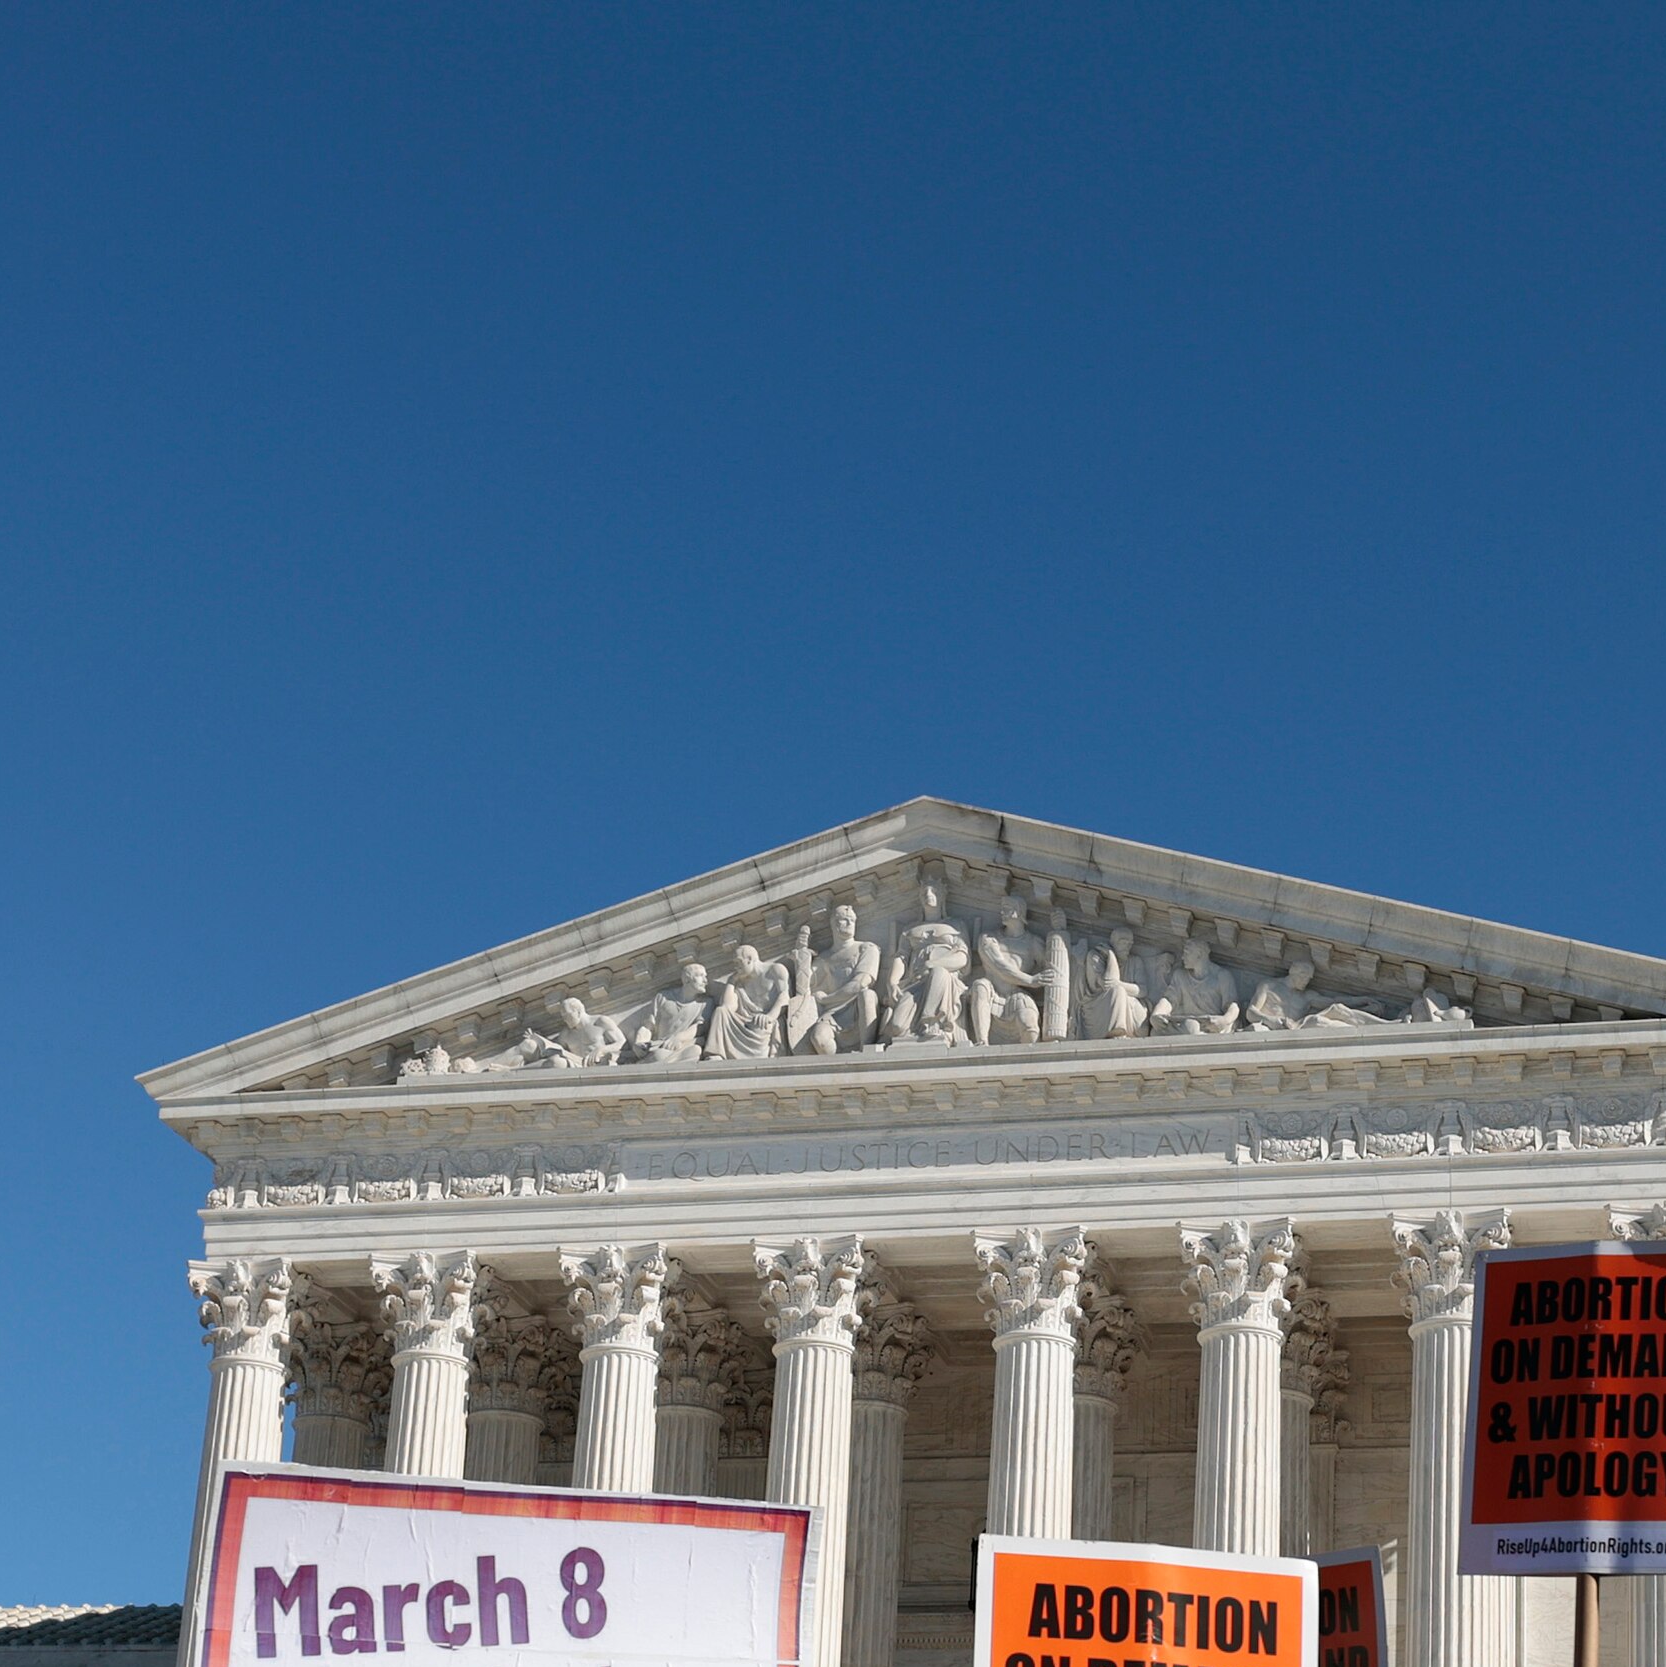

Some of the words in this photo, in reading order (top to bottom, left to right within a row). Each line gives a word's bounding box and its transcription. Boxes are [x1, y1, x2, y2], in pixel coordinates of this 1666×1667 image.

[647, 1151, 780, 1182] EQUAL
[791, 1140, 951, 1174] JUSTICE
[974, 1132, 1112, 1165] UNDER
[1132, 1128, 1210, 1159] LAW
[1490, 1338, 1540, 1384] ON
[1488, 1402, 1517, 1443] &
[254, 1555, 530, 1658] March
[560, 1547, 607, 1640] 8
[1028, 1583, 1278, 1655] ABORTION
